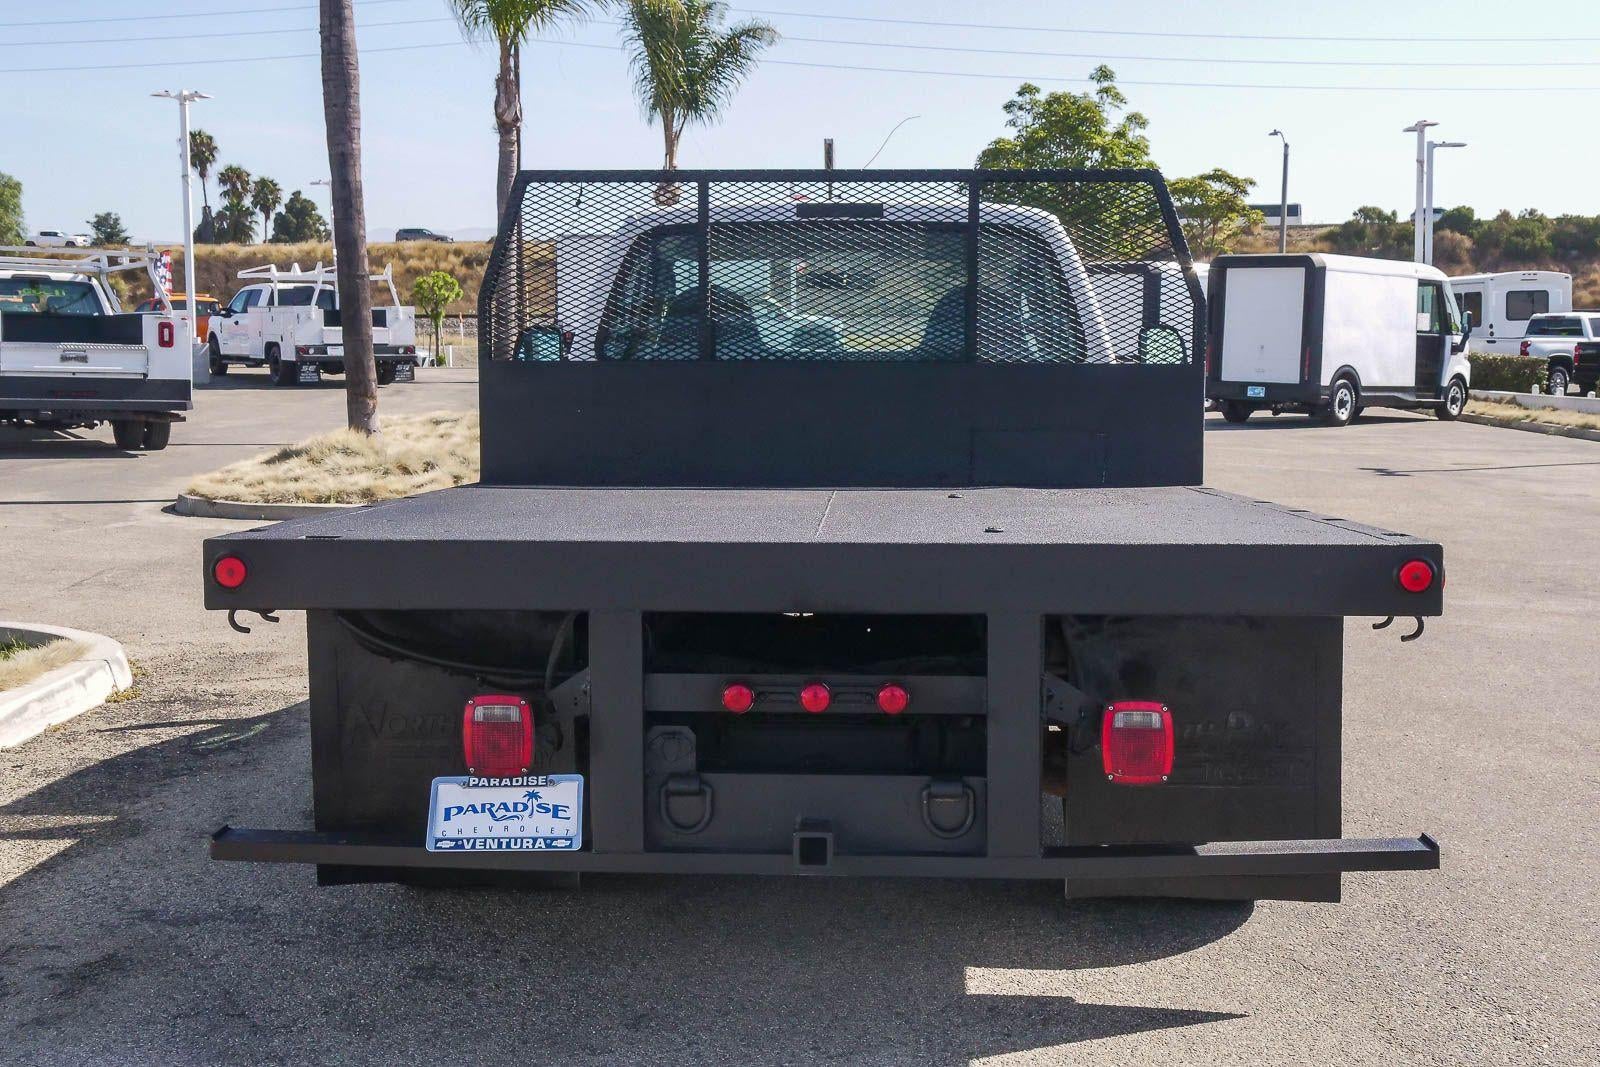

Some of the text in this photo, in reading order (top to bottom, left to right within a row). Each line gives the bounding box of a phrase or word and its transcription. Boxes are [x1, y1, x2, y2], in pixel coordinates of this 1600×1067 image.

[470, 775, 547, 787] PARADISE
[443, 795, 571, 821] PARADISE
[463, 838, 547, 850] VENTURA
